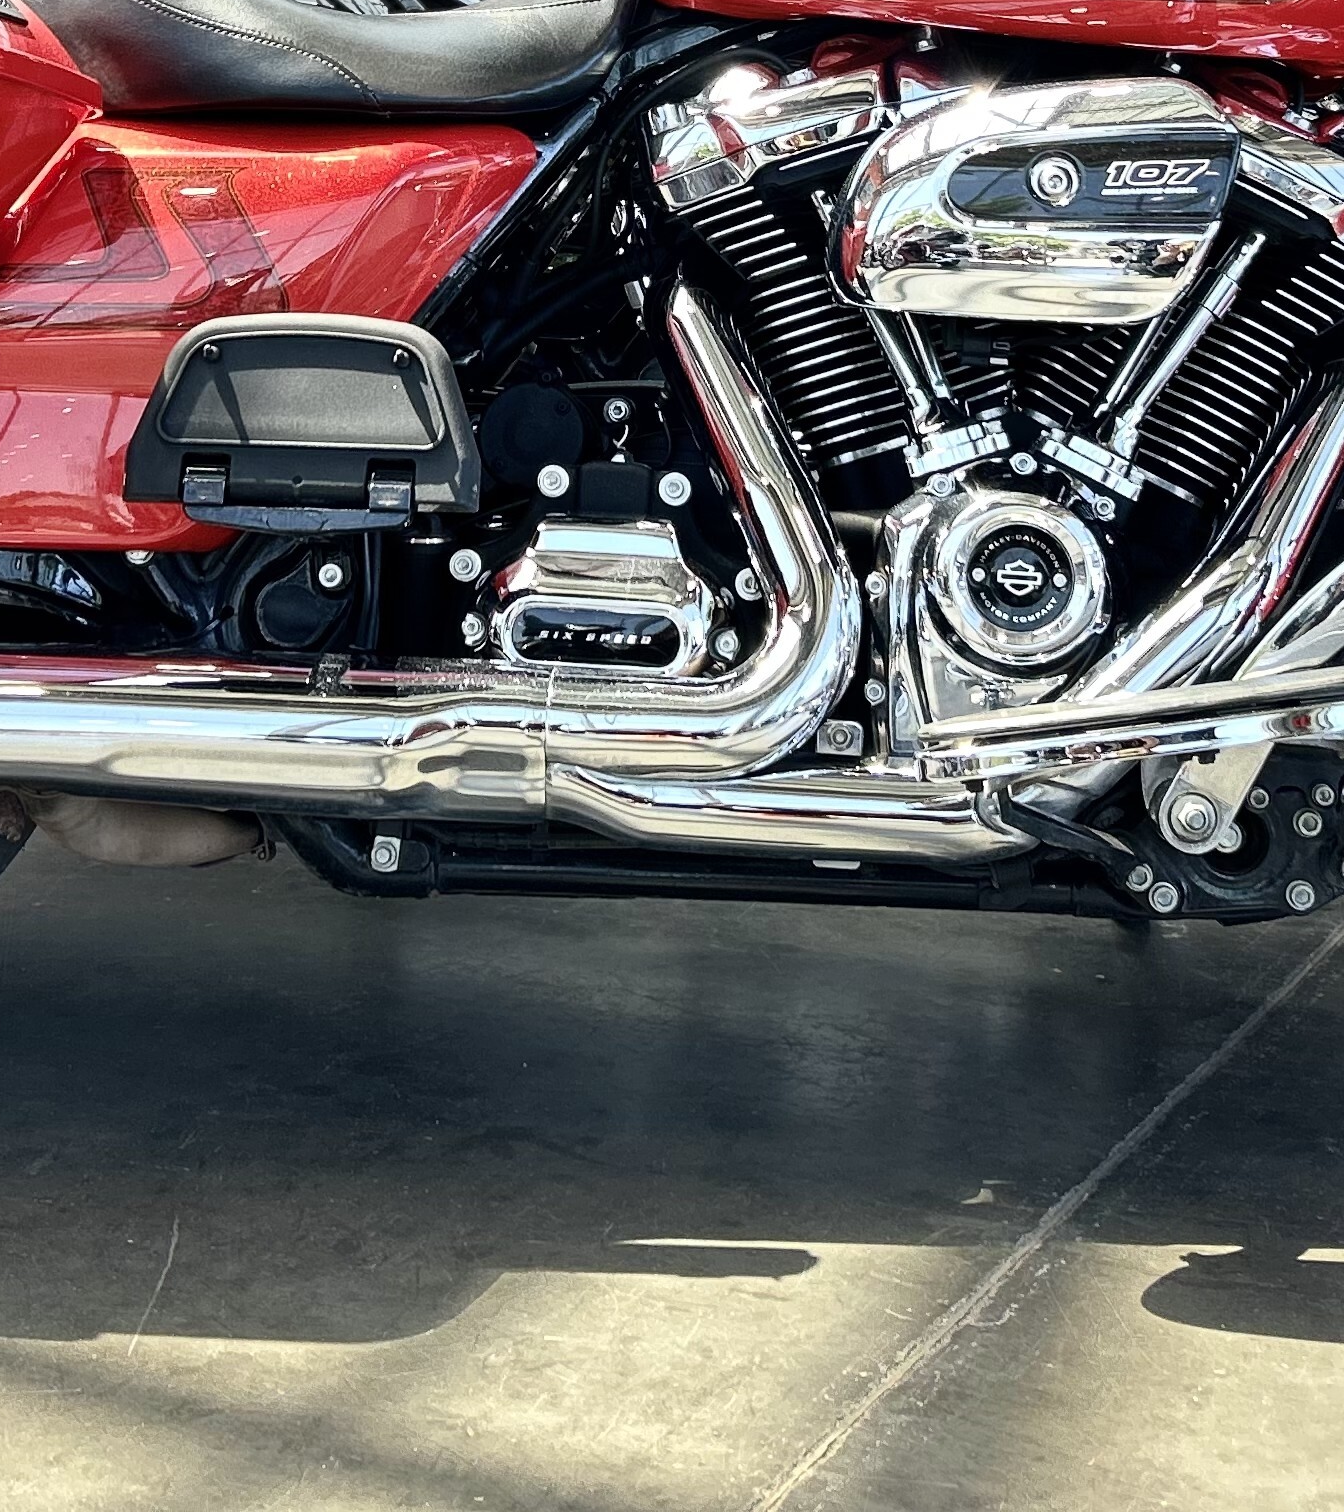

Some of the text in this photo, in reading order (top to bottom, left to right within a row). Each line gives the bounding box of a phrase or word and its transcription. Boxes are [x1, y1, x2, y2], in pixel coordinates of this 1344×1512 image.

[1104, 158, 1211, 187] 107
[979, 534, 1060, 569] HARLEY-DAVIDSON
[979, 592, 1058, 624] MOTOR COMPANY
[539, 630, 574, 641] SIX
